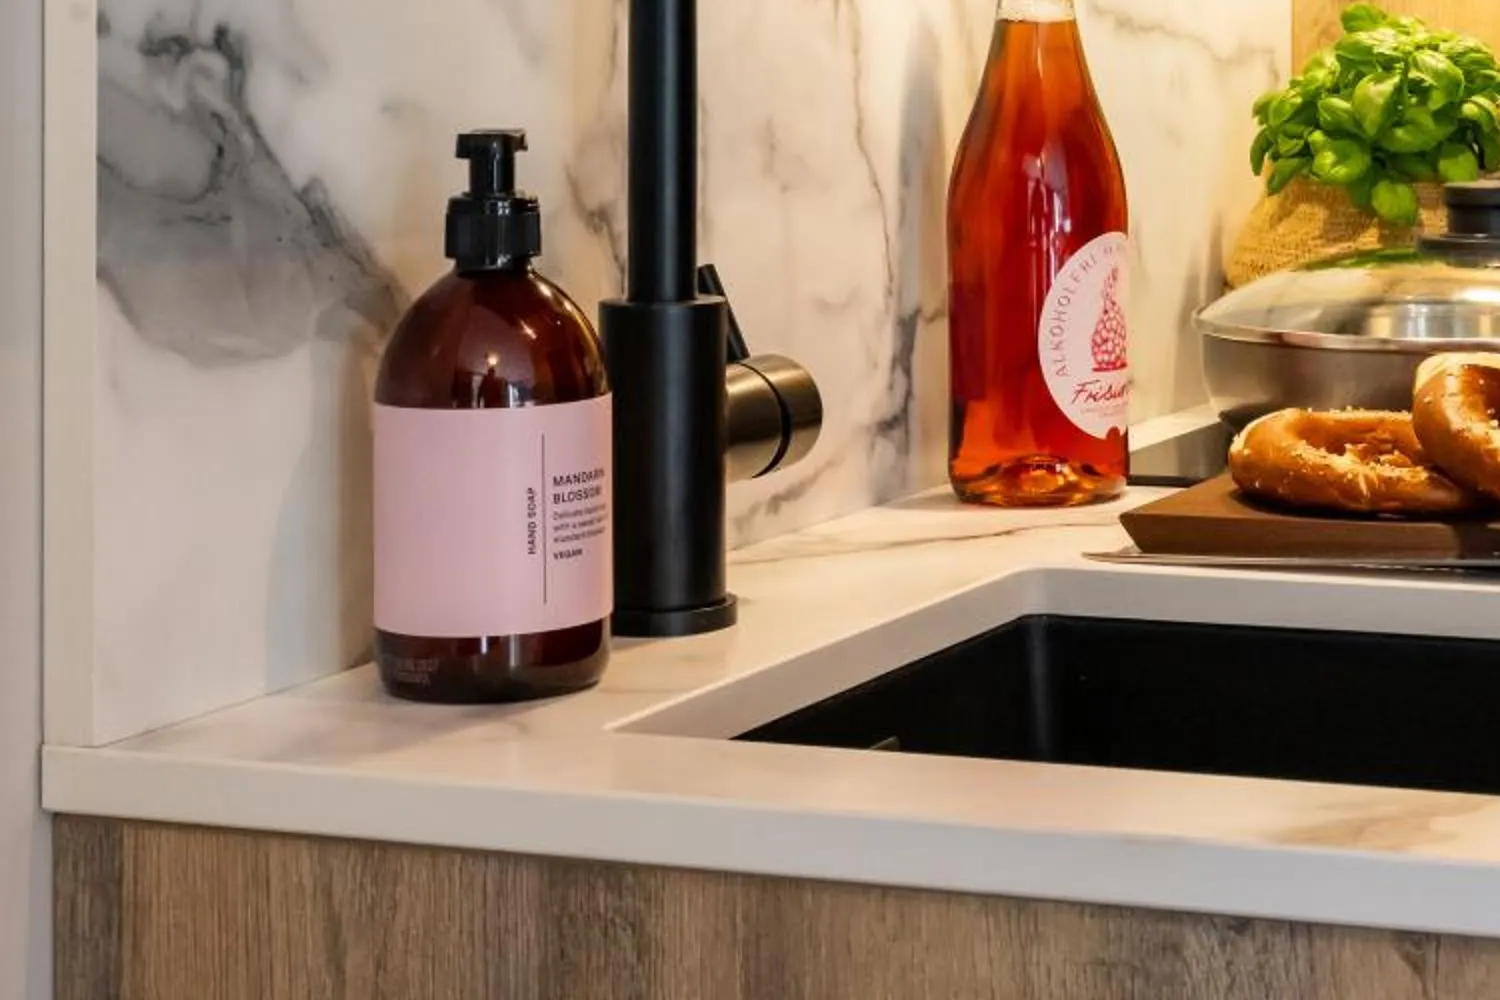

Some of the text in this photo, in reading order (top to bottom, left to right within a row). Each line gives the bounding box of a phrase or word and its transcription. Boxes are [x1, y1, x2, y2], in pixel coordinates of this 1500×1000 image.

[527, 486, 537, 555] HAND SOAP
[553, 548, 583, 560] VEGAN
